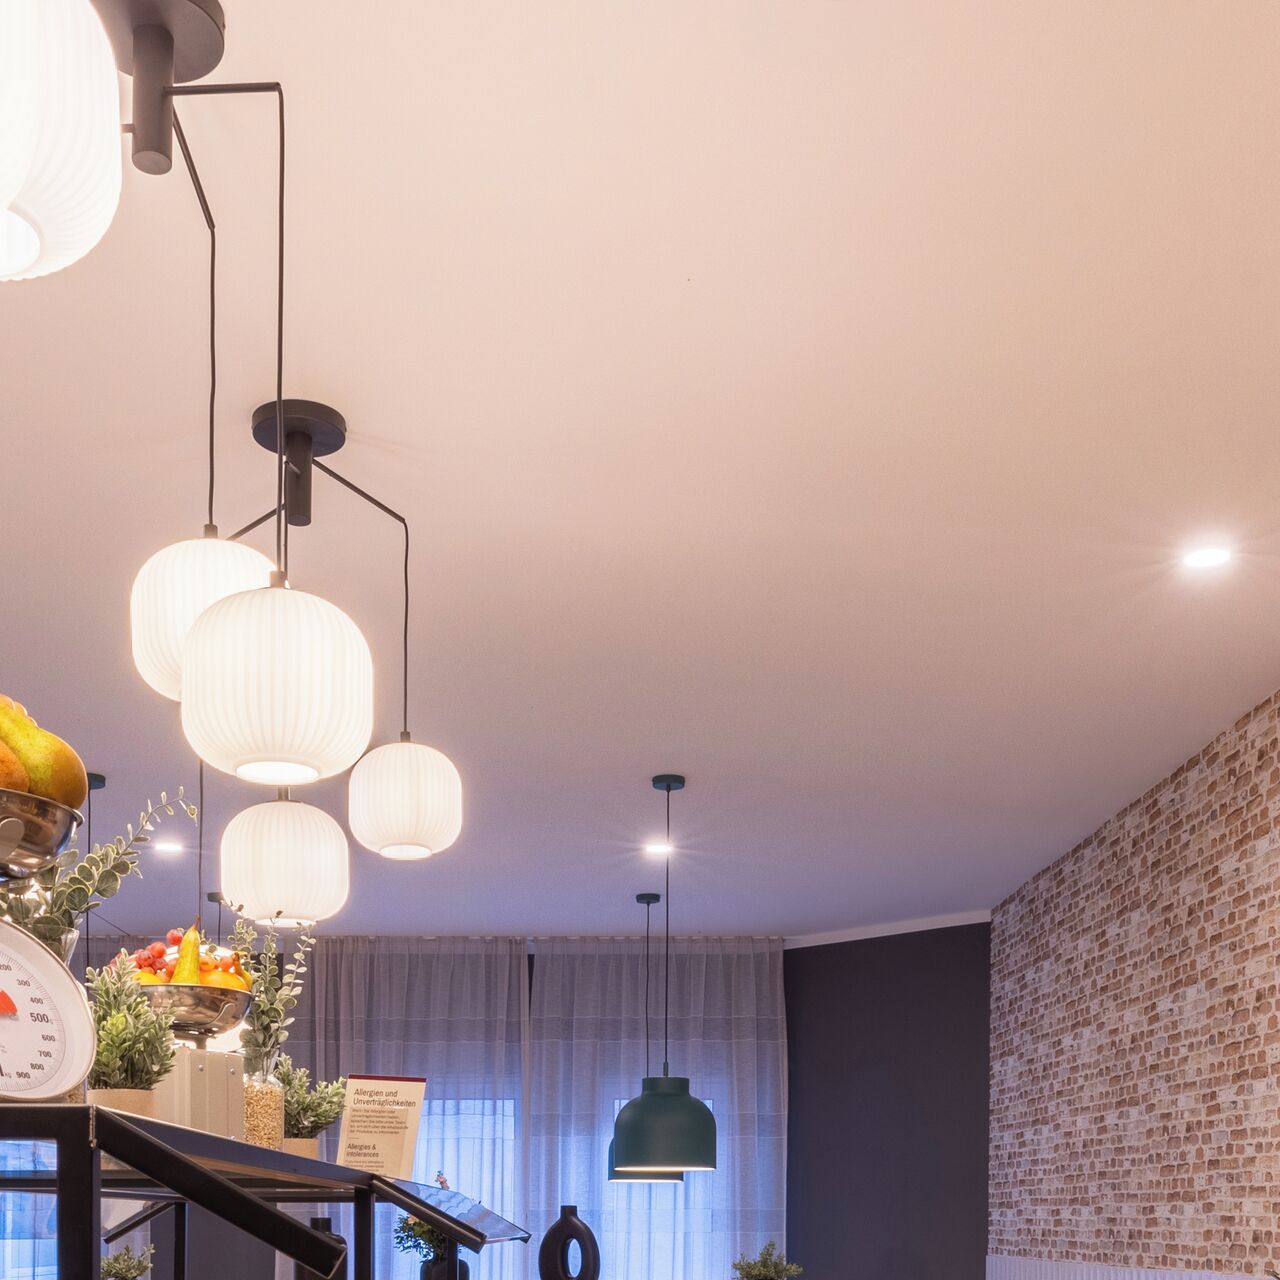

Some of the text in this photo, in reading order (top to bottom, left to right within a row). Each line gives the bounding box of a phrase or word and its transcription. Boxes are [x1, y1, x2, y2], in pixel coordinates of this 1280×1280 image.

[16, 979, 31, 987] 300
[30, 997, 44, 1005] 400
[41, 1034, 56, 1042] 600
[38, 1050, 52, 1058] 700
[30, 1063, 45, 1071] 800
[16, 1071, 31, 1079] 900
[354, 1088, 398, 1098] Allergien und
[353, 1098, 416, 1108] Unverträglichkeiten
[347, 1143, 371, 1151] Allergies
